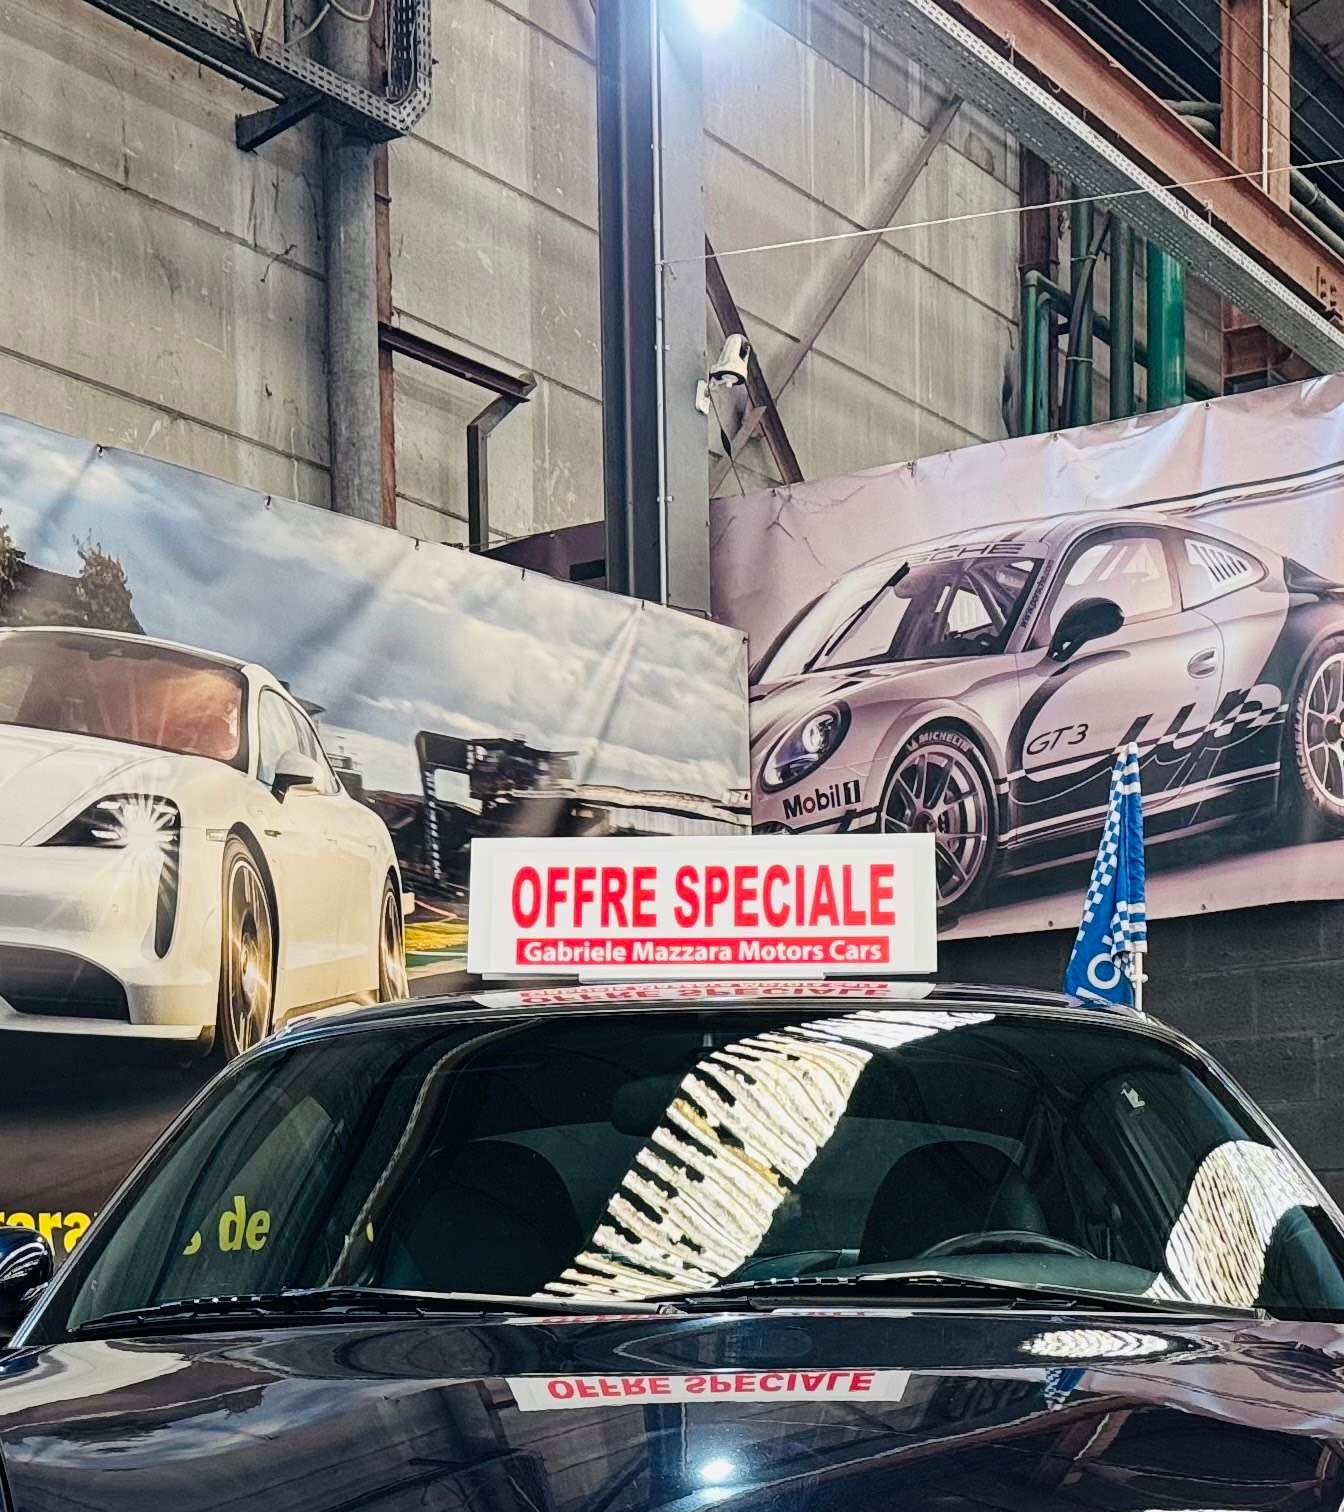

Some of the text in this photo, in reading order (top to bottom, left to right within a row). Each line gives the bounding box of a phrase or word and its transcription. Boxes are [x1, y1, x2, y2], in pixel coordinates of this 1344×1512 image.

[783, 783, 841, 820] Mobil
[511, 862, 896, 929] OFFRE SPECIALE
[523, 939, 883, 963] Gabriele Mazzara Motors Cars
[218, 1195, 271, 1252] de
